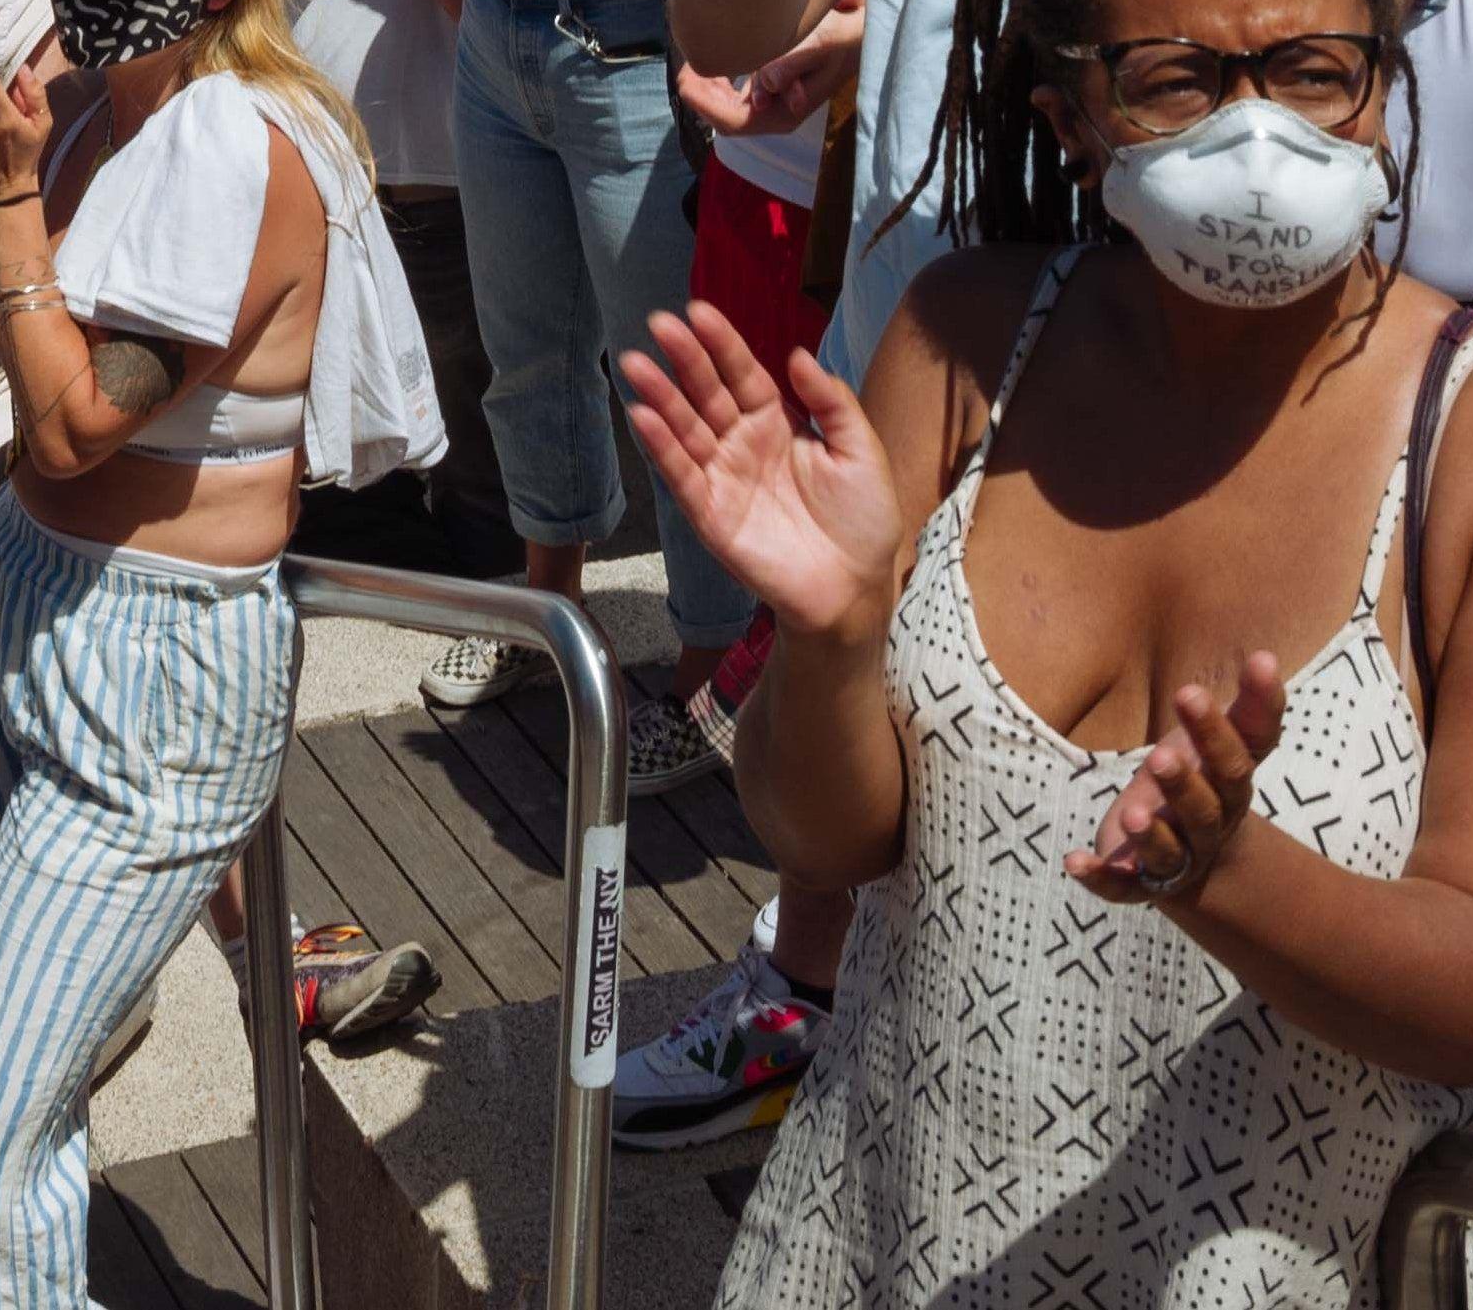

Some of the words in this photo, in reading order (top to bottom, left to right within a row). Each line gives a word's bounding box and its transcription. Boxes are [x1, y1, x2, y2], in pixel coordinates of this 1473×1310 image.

[1243, 189, 1274, 222] I
[1194, 212, 1311, 251] STAND
[1181, 259, 1299, 297] TRANS
[1226, 245, 1294, 275] FOR
[596, 914, 617, 968] THE
[589, 969, 614, 1052] SARM
